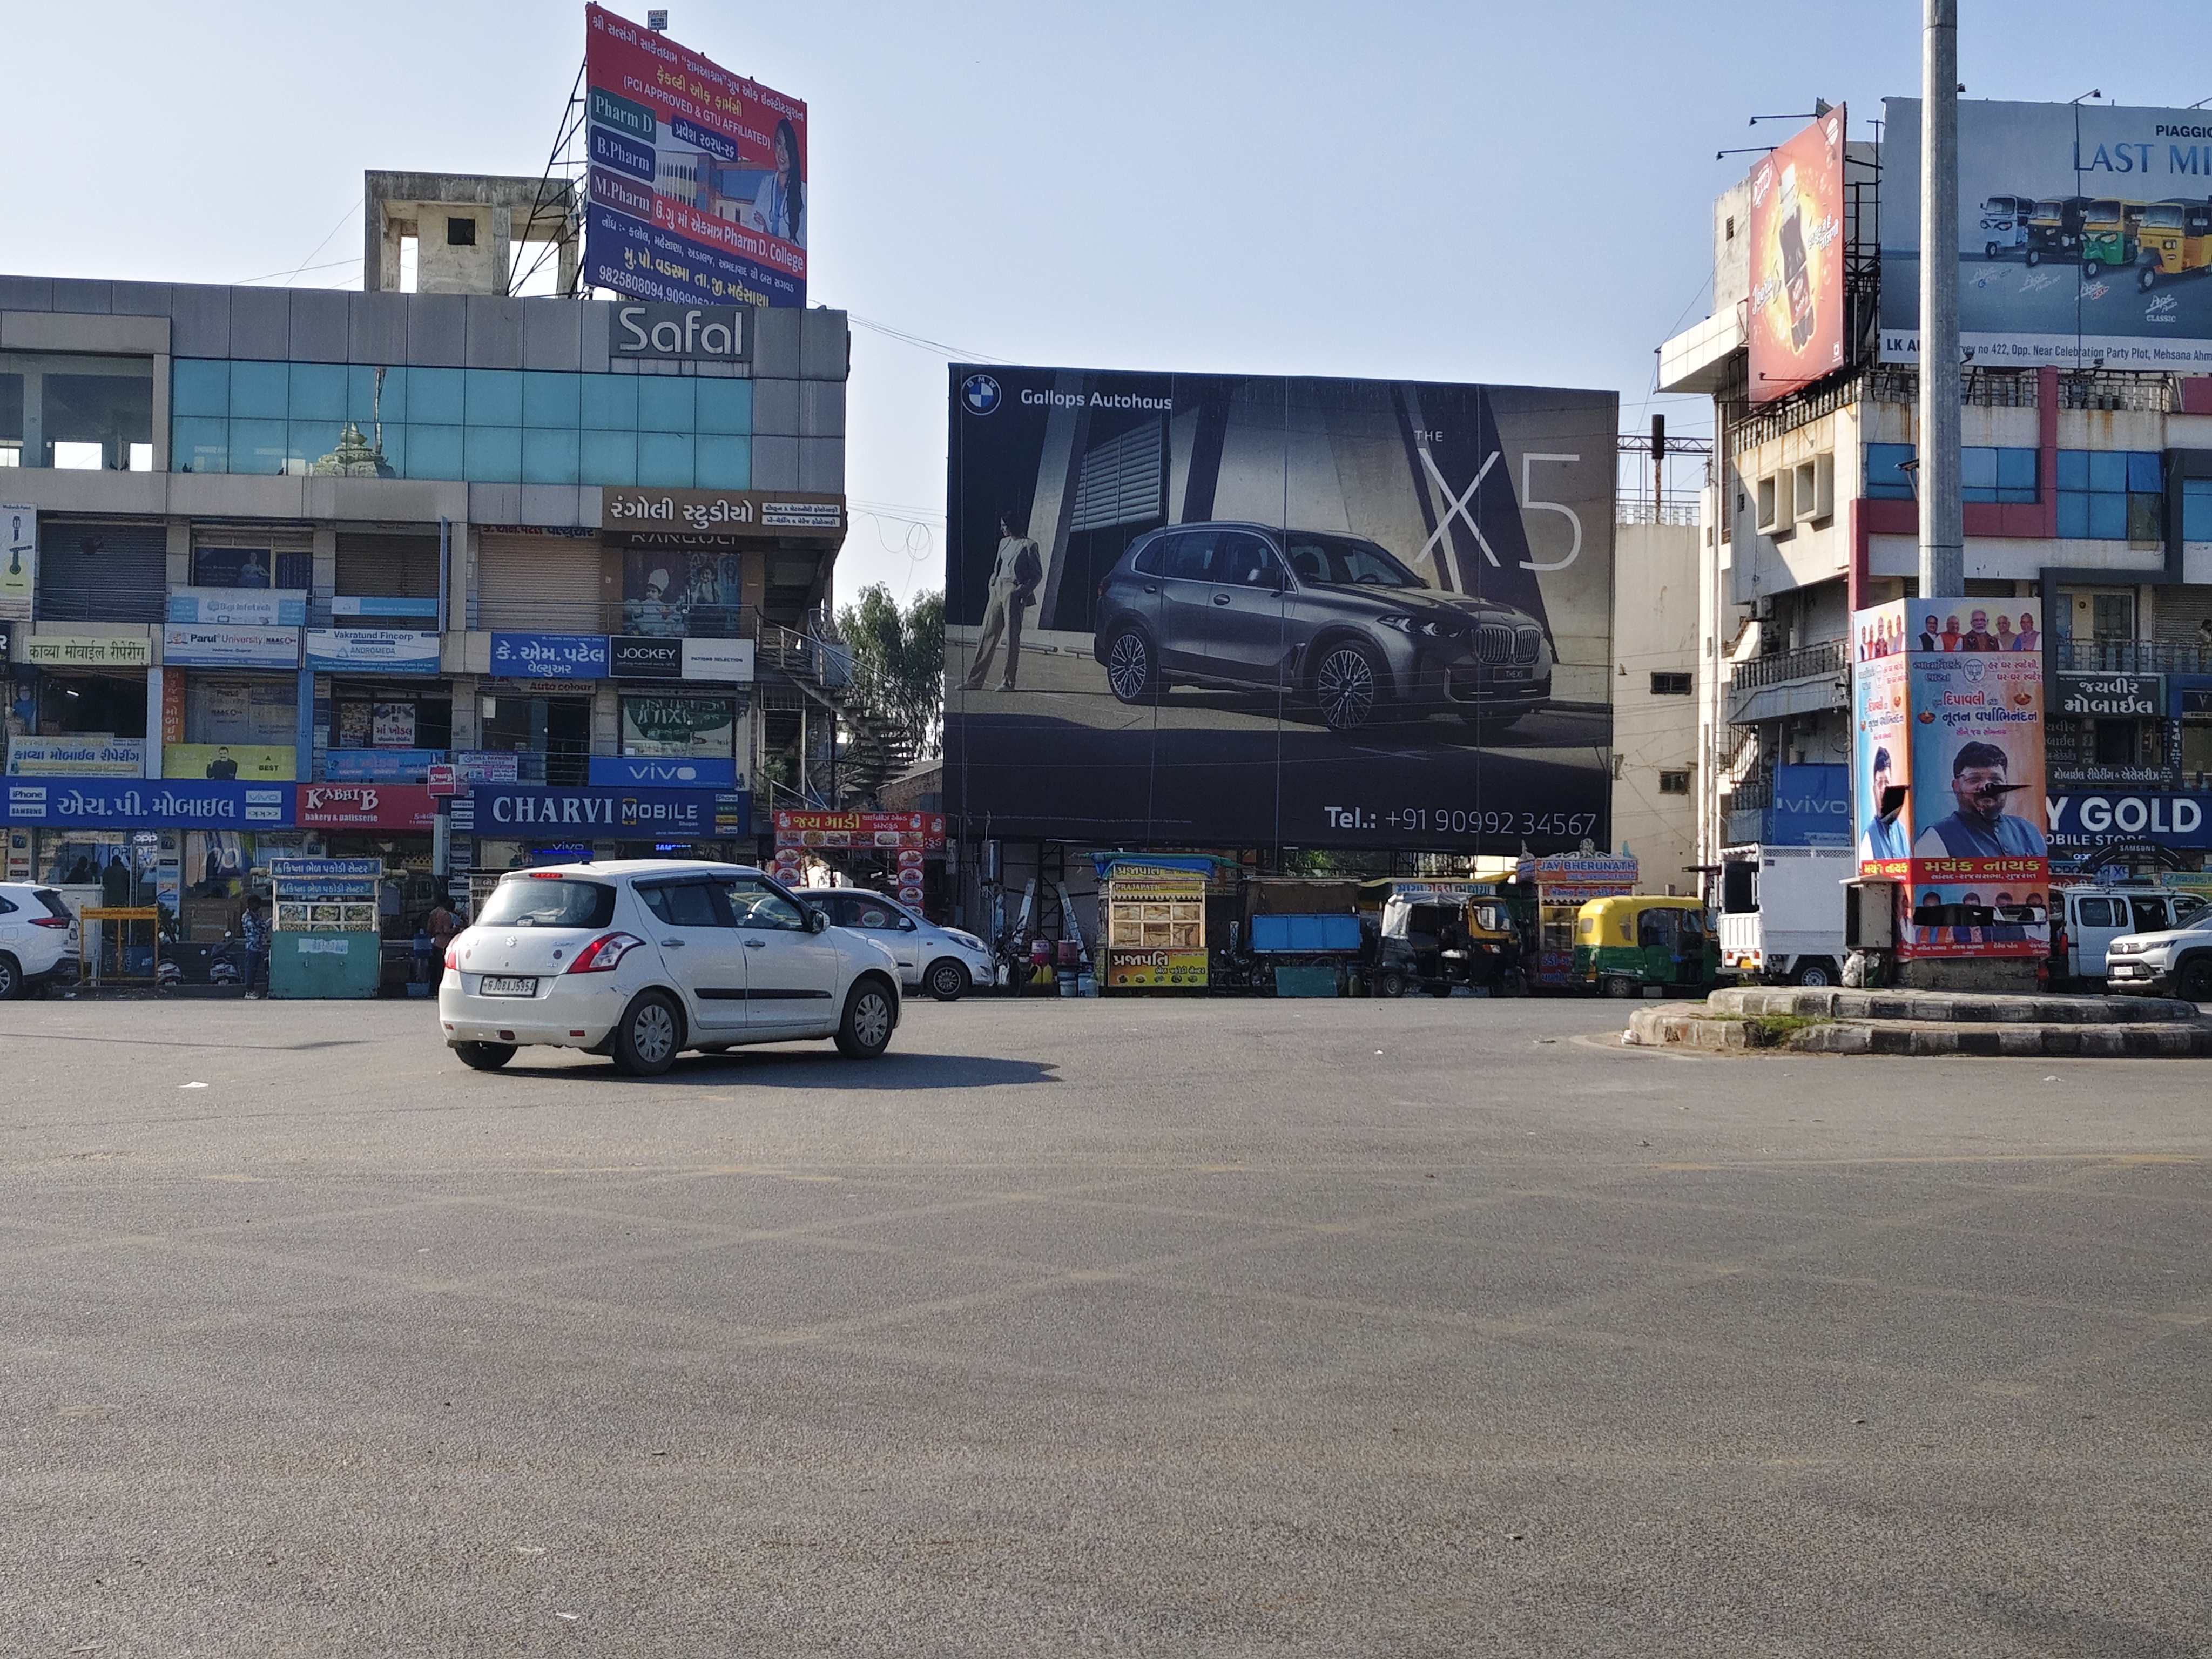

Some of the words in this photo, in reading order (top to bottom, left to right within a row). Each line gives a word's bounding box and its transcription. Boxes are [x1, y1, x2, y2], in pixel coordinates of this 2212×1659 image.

[690, 82, 711, 105] ઓફ
[595, 95, 638, 129] Pharm
[643, 113, 652, 132] D
[623, 75, 642, 93] (PCI
[644, 84, 692, 114] APPROVED
[694, 106, 702, 119] &
[703, 110, 721, 126] GTU
[722, 118, 771, 150] AFFILIATED)
[676, 120, 696, 143] પ્રવેશ
[597, 135, 650, 172] B.Pharm
[2073, 141, 2155, 173] LAST
[594, 174, 650, 212] M.Pharm
[725, 226, 757, 254] Pharm
[759, 238, 768, 258] D.
[770, 242, 804, 273] College
[2146, 314, 2176, 323] CLASSIC
[619, 307, 743, 355] Safal
[1886, 338, 1903, 351] LK
[1979, 346, 1988, 354] no
[1991, 343, 2009, 356] 422,
[2012, 344, 2031, 357] Opp.
[2033, 346, 2053, 357] Near
[2055, 345, 2104, 358] Celebration
[2107, 347, 2129, 360] Party
[2132, 348, 2151, 361] Plot,
[2154, 349, 2191, 361] Mehsana
[967, 376, 996, 388] BMW
[1021, 389, 1085, 408] Gallops
[1090, 392, 1172, 410] Autohaus
[1415, 430, 1444, 442] THE
[610, 495, 674, 521] રંગોલી
[682, 498, 755, 530] સ્ટુડીયો
[1415, 447, 1582, 571] X5
[190, 634, 217, 643] Parul
[221, 635, 263, 645] University
[334, 631, 377, 639] Vakratund
[380, 631, 414, 642] Fincorp
[29, 645, 60, 659] काव्या
[563, 642, 605, 663] પટેલ
[617, 648, 676, 660] JOCKEY
[528, 660, 572, 677] વેલ્યુઅર
[529, 682, 556, 691] Auto
[558, 683, 592, 691] colour
[2079, 678, 2139, 694] જયવીર
[1944, 690, 1985, 706] દિપાવલી
[2064, 693, 2154, 714] મોબાઈલ
[1941, 711, 1971, 727] નૂતન
[1975, 707, 2038, 722] વર્ષાભિનંદન
[14, 748, 45, 760] કાવ્યા
[628, 762, 697, 780] vivo
[12, 790, 43, 799] iPhone
[249, 793, 278, 801] vivo
[305, 788, 359, 810] KABHI
[360, 789, 379, 810] B
[11, 807, 43, 815] SAMSUNG
[493, 796, 614, 824] CHARVI
[622, 803, 699, 821] MOBILE
[1785, 795, 1848, 814] vivo
[305, 813, 331, 822] bakery
[339, 813, 378, 822] patisserie
[793, 816, 820, 828] જય
[1325, 806, 1376, 828] Tel.:
[1386, 808, 1426, 831] +91
[1434, 810, 1514, 834] 90992
[1521, 813, 1596, 835] 34567
[2046, 796, 2069, 831] Y
[2080, 796, 2202, 832] GOLD
[552, 841, 585, 851] vivo
[2046, 834, 2090, 845] OBILE
[1539, 861, 1560, 871] JAY
[1564, 861, 1636, 871] BHERUNATH
[1924, 858, 1974, 873] મયંક
[1982, 860, 2041, 872] નાયક
[1113, 950, 1169, 966] પ્રજાપતિ
